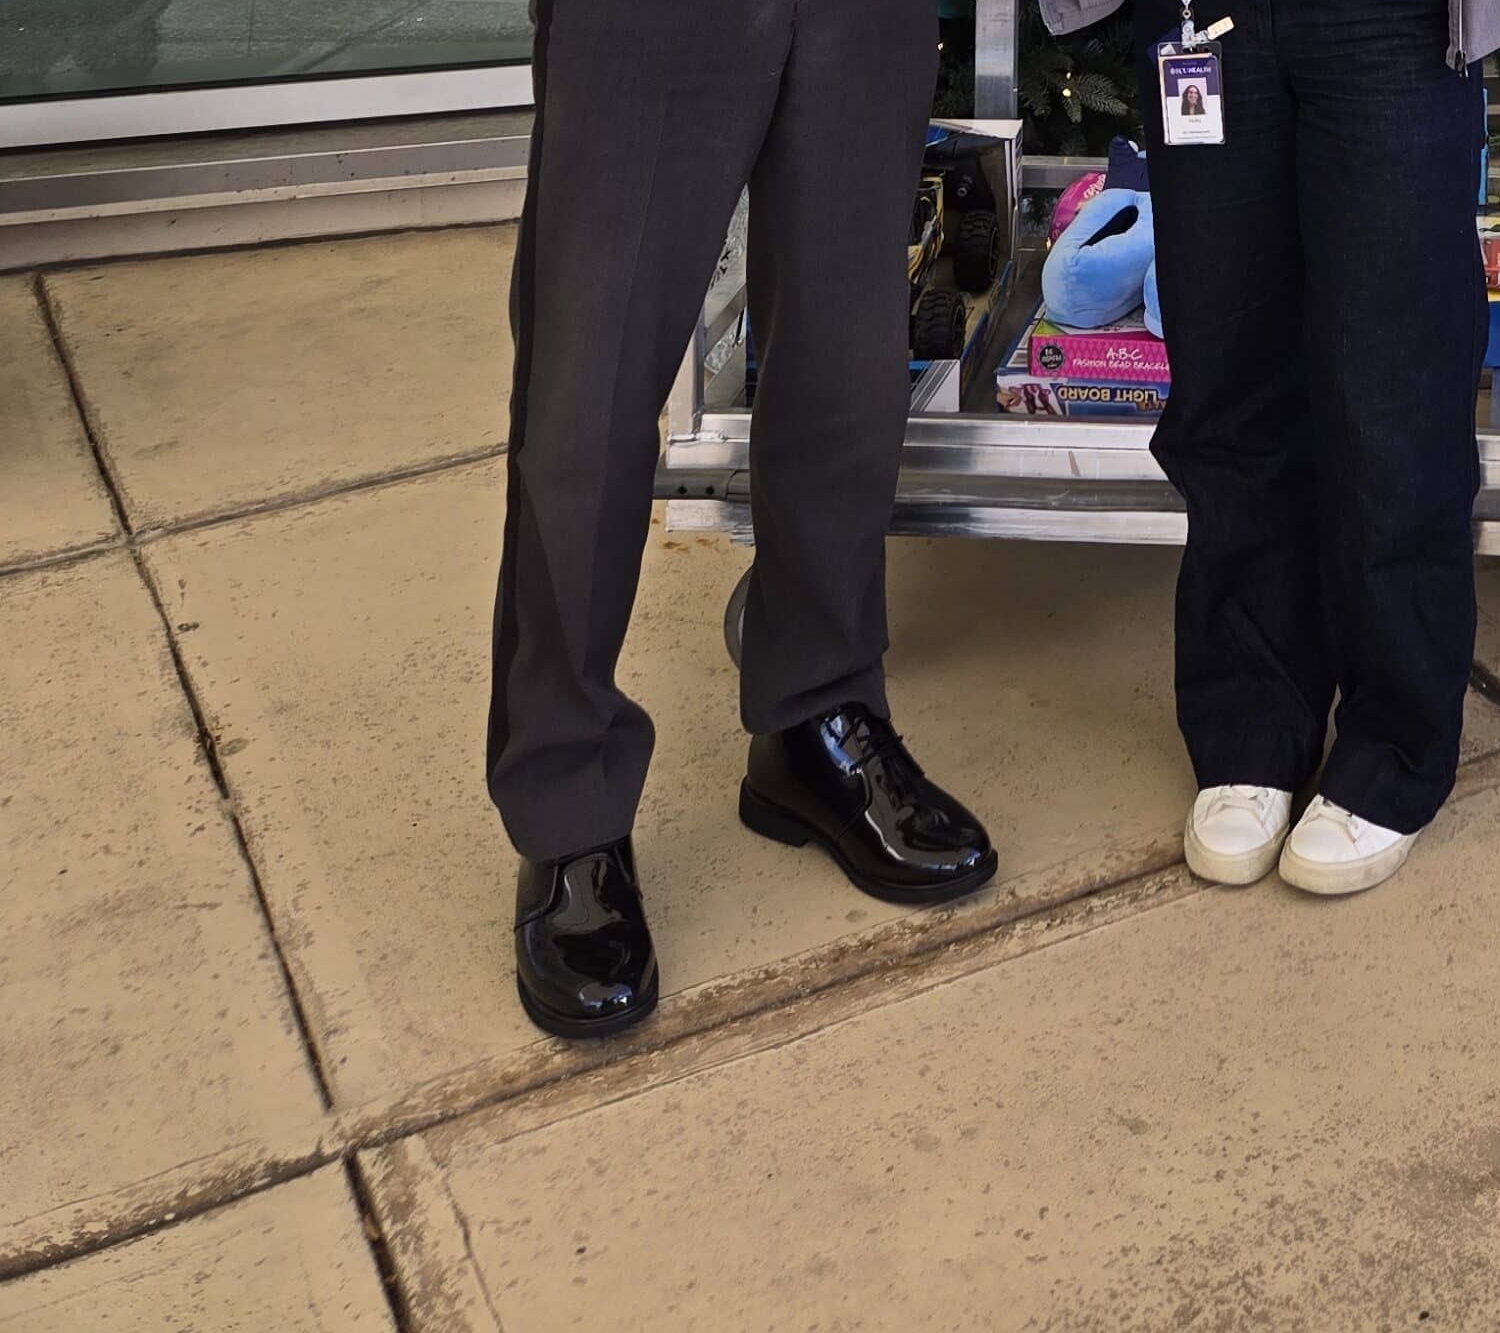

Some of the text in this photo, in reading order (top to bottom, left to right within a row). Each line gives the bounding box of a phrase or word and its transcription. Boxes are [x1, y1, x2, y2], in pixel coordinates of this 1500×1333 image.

[1072, 358, 1107, 368] FASHION
[1108, 359, 1131, 369] BEAD
[1057, 386, 1110, 401] BOARD
